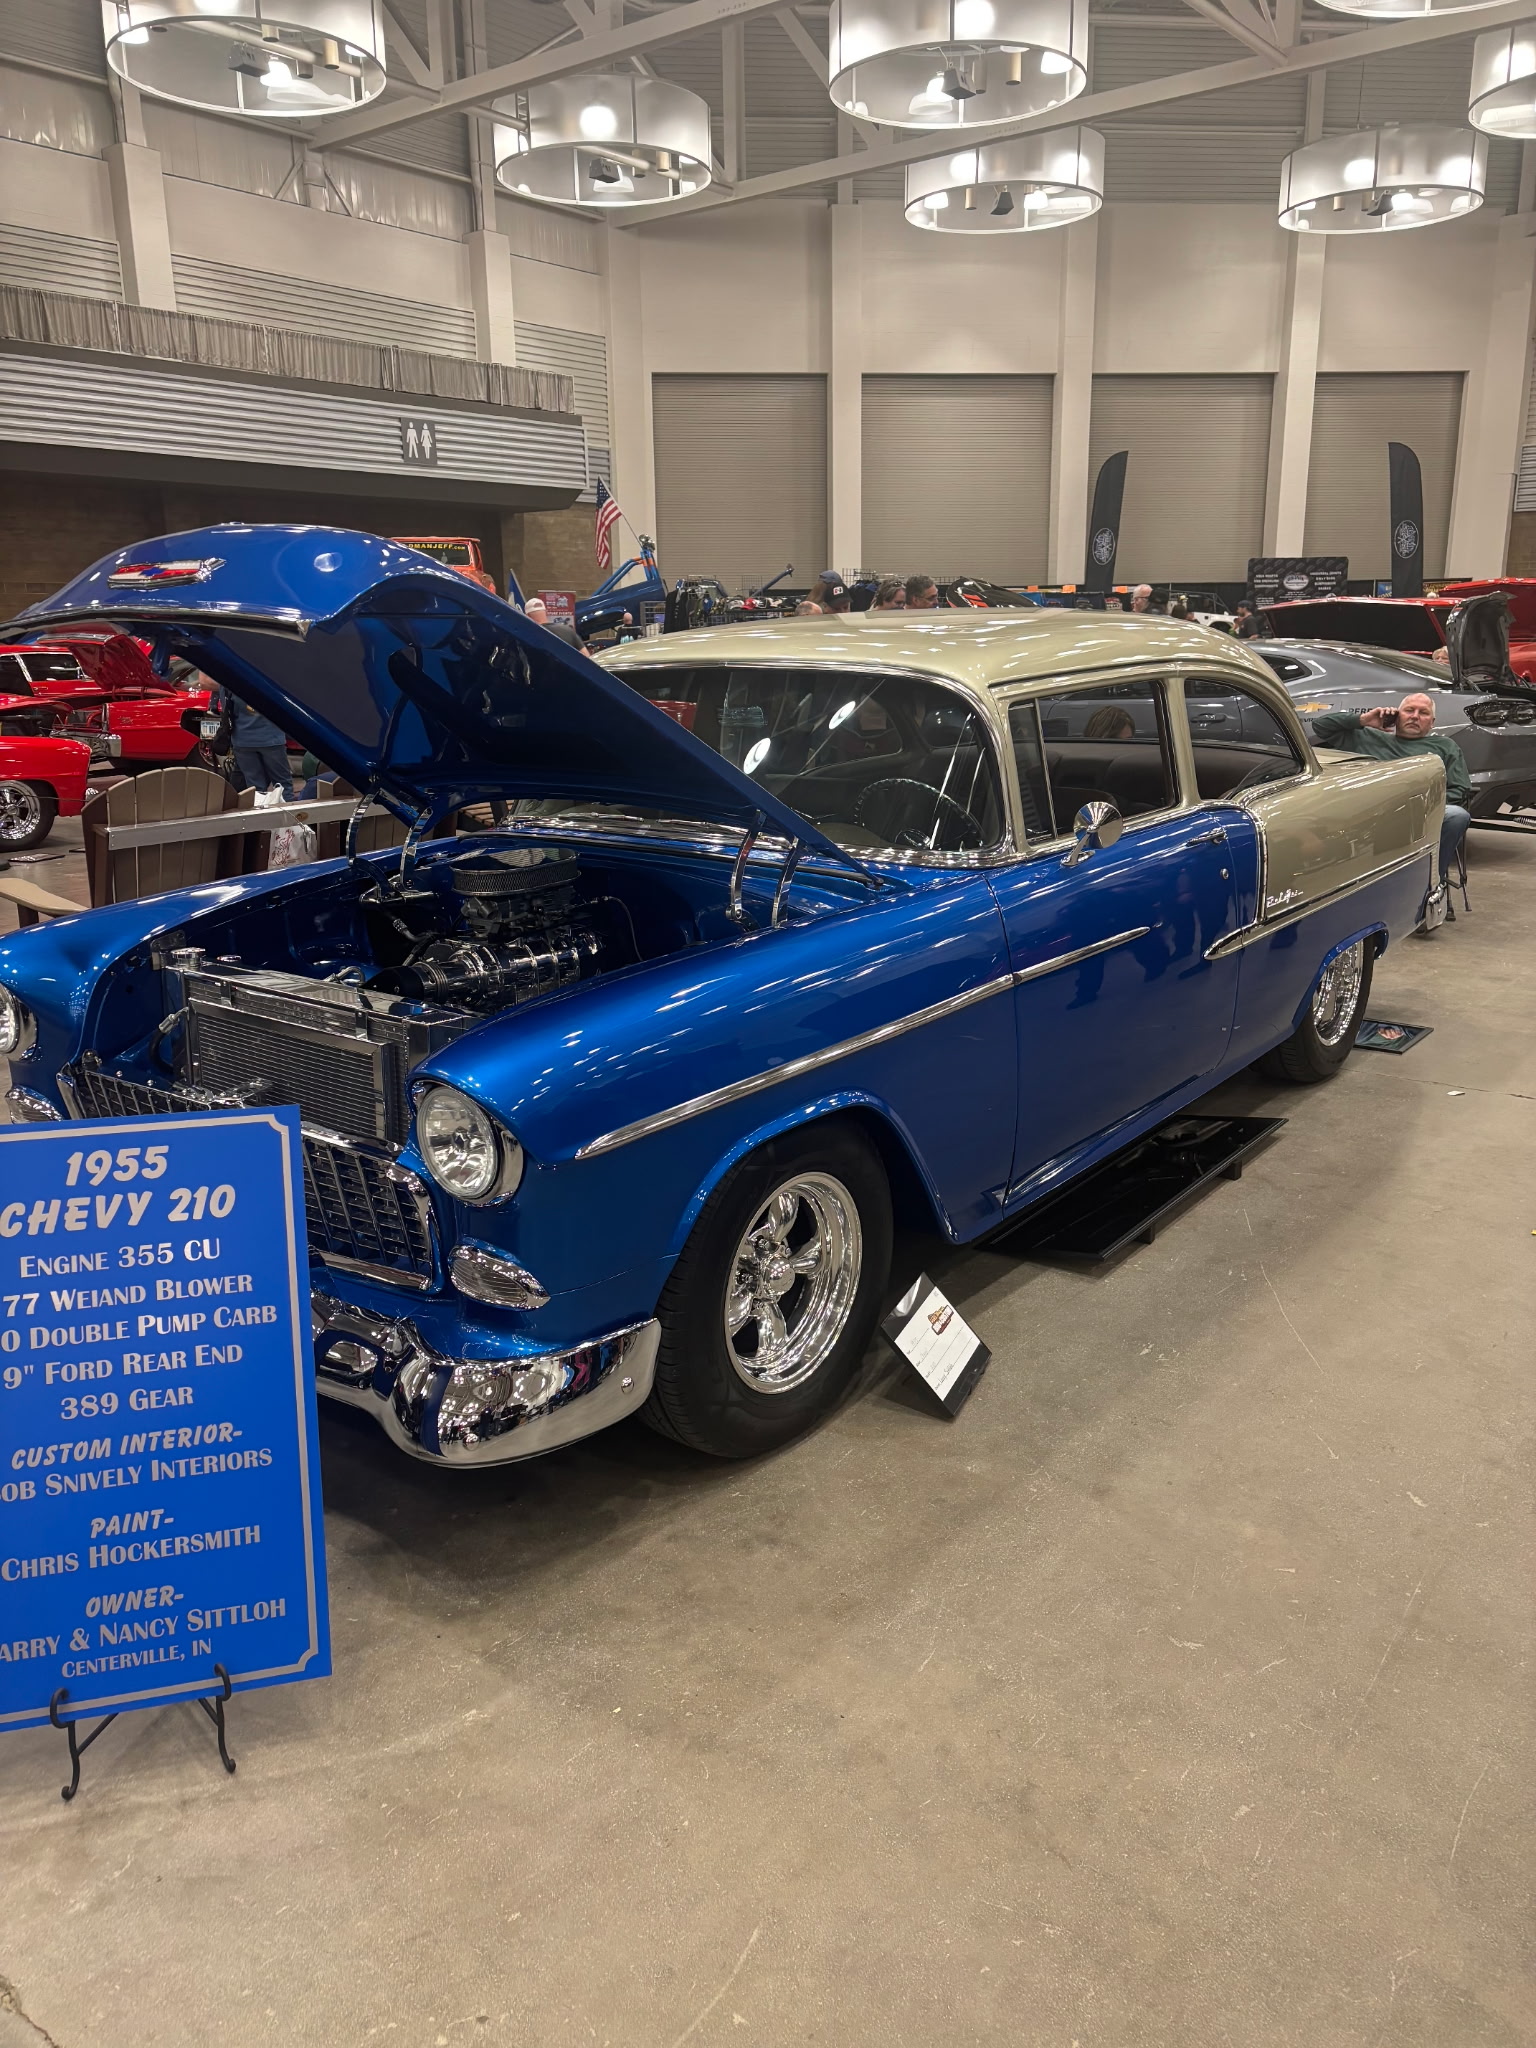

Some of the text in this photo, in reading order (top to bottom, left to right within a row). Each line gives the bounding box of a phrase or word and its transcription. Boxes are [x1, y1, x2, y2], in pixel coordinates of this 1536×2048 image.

[66, 1145, 169, 1186] 1955
[0, 1184, 236, 1237] CHEVY 210
[20, 1237, 220, 1278] ENGINE 355 CU
[2, 1274, 253, 1318] 77 WEIAND BLOWER
[29, 1321, 131, 1350] DOUBLE
[137, 1312, 207, 1337] PUMP
[213, 1305, 278, 1329] CARB
[2, 1344, 243, 1390] 9" FORD REAR END
[60, 1386, 194, 1420] 389 GEAR
[11, 1422, 243, 1470] CUSTOM INTERIOR-
[0, 1448, 273, 1502] OB SNIVELY INTERIORS
[90, 1508, 174, 1539] PAINT-
[1, 1525, 260, 1581] CHRIS HOCKERSMITH
[85, 1585, 184, 1618] OWNER-
[69, 1628, 90, 1652] &
[100, 1616, 179, 1647] NANCY
[187, 1598, 286, 1632] SITTLOH
[62, 1638, 212, 1678] CENTERVILLE, IN
